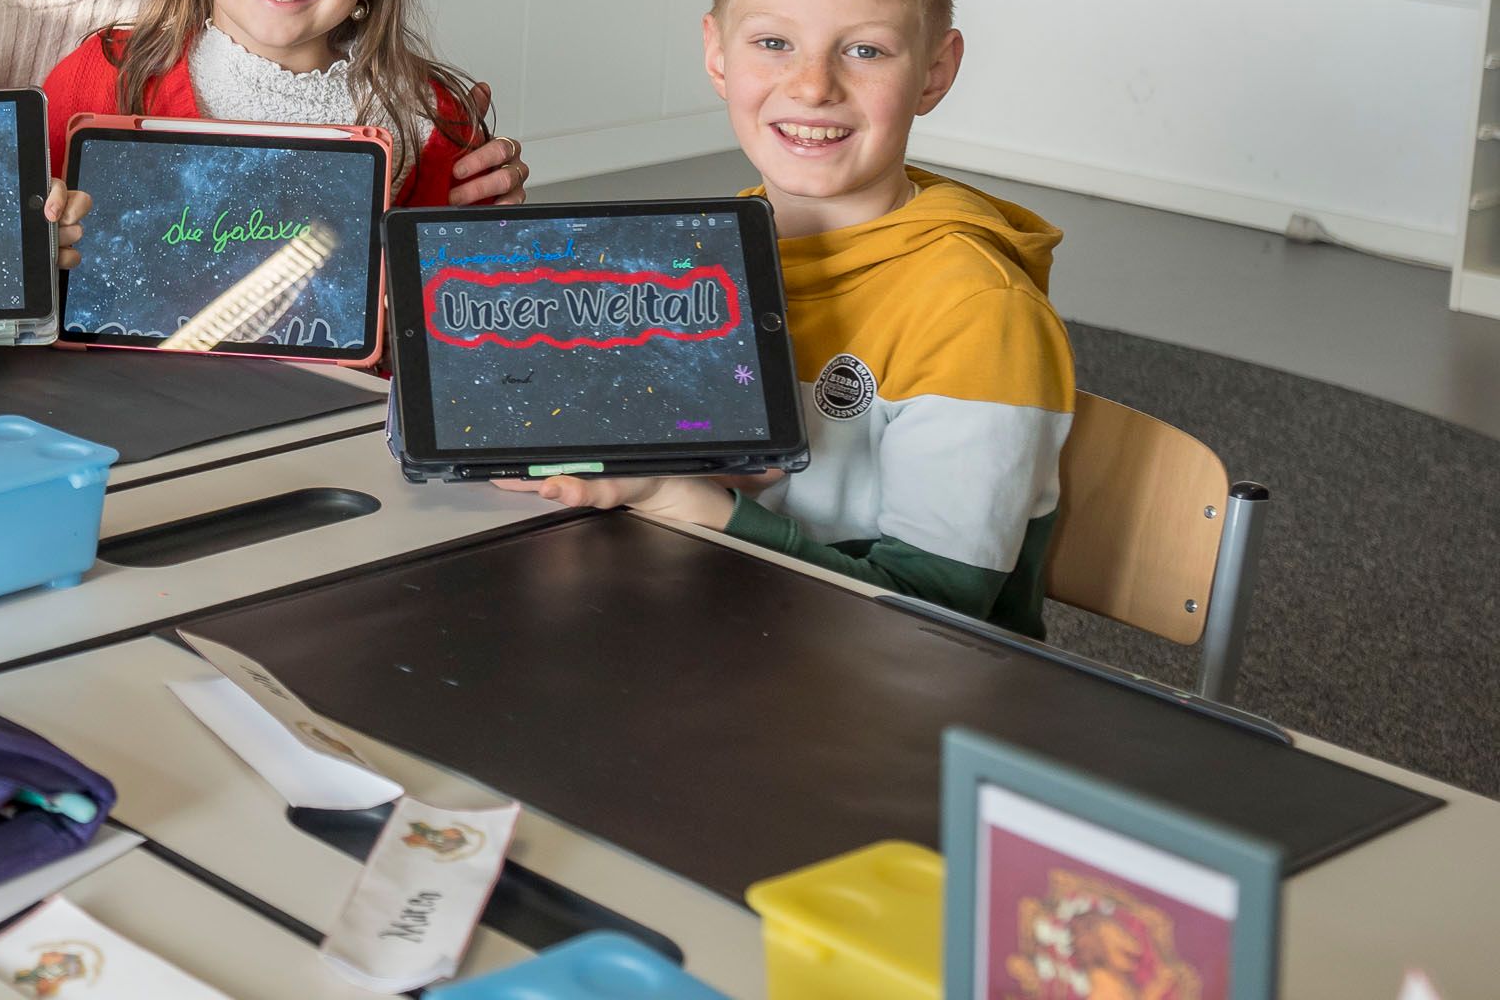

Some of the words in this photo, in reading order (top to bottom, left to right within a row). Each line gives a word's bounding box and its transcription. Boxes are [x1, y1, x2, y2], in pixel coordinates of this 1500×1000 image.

[162, 206, 203, 245] die
[440, 290, 560, 331] Unser
[562, 279, 720, 326] Weltall
